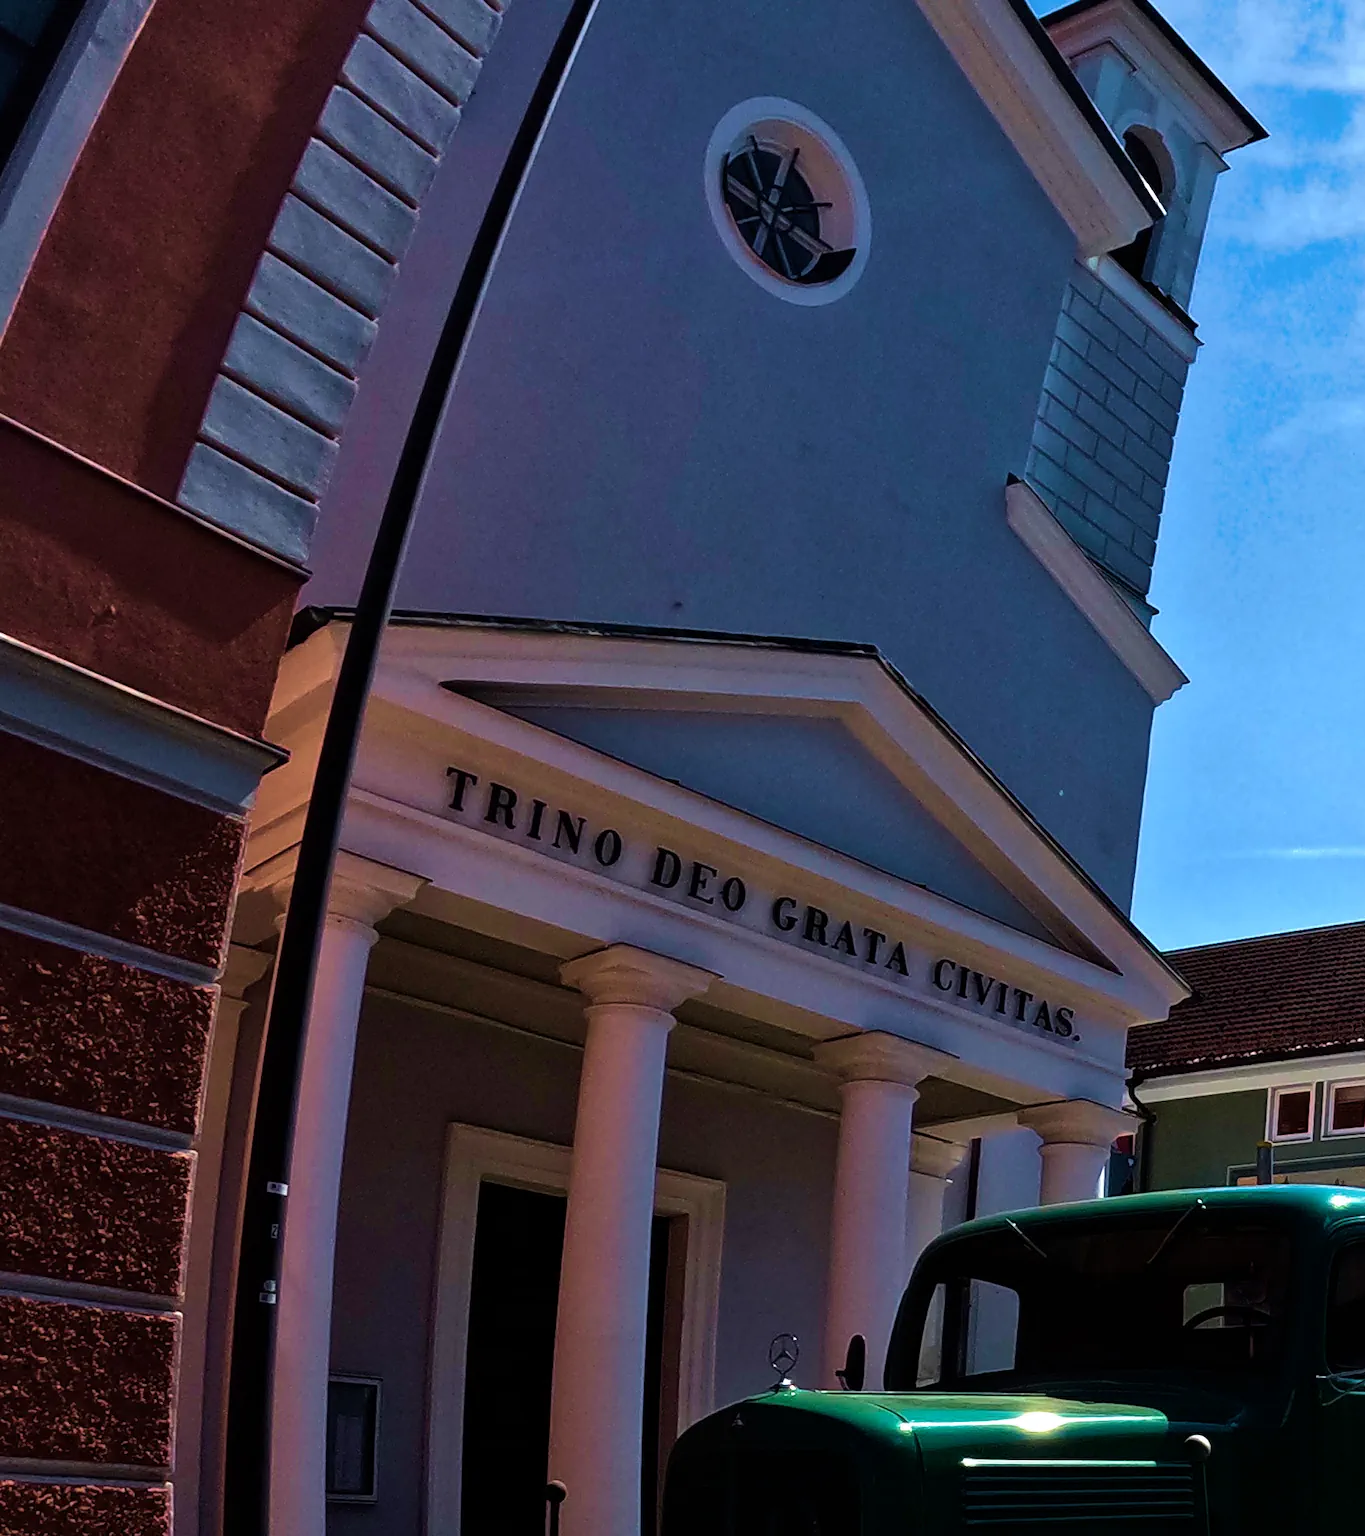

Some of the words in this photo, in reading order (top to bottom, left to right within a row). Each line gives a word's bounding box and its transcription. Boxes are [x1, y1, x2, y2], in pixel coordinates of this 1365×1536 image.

[446, 766, 623, 867] TRINO
[650, 846, 746, 912] DEO
[772, 896, 910, 977] GRATA
[931, 958, 1082, 1042] CIVITAS.
